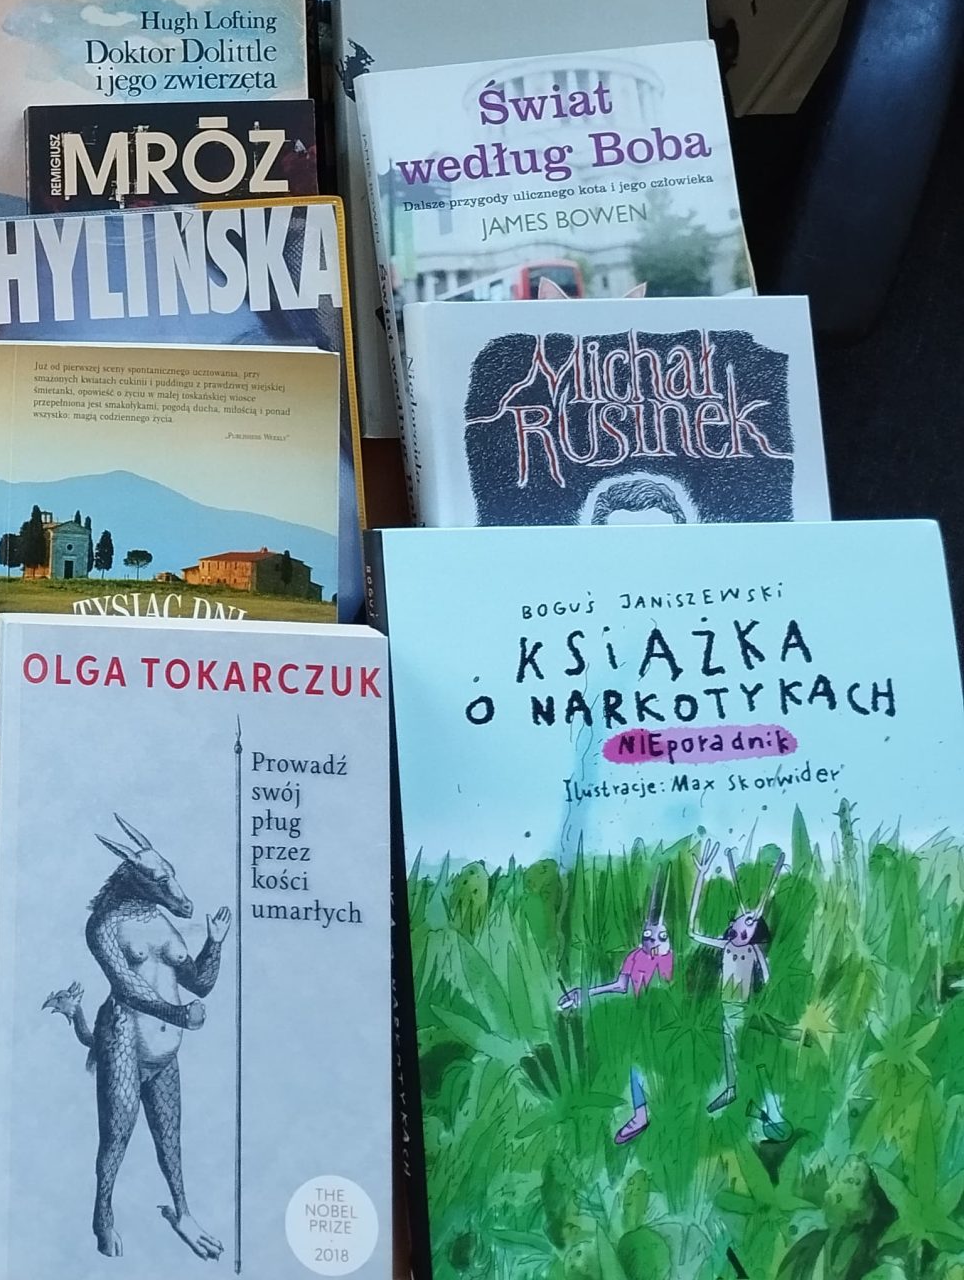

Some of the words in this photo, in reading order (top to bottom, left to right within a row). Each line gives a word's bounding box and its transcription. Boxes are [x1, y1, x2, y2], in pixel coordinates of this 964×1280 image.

[141, 11, 197, 34] Hugh
[204, 11, 277, 33] Lofting
[85, 40, 175, 64] Doktor
[181, 39, 277, 63] Dolittle
[95, 67, 102, 90] i
[105, 67, 156, 96] jego
[164, 66, 277, 93] zwierzęta
[478, 79, 613, 125] Świat
[50, 133, 61, 196] REMIGIUSZ
[396, 142, 573, 185] według
[589, 127, 712, 168] Boba
[404, 200, 445, 212] Dalsze
[449, 193, 508, 210] przygody
[513, 188, 574, 202] ulicznego
[578, 182, 607, 196] kota
[612, 182, 615, 192] i
[619, 180, 646, 193] jego
[650, 174, 713, 188] człowieka
[482, 214, 548, 241] JAMES
[556, 203, 647, 229] BOWEN
[23, 653, 126, 687] OLGA
[141, 658, 382, 698] TOKARCZUK
[466, 695, 494, 725] O
[531, 675, 896, 728] NARKOTYKACH
[251, 752, 347, 776] Prowadź
[251, 783, 301, 808] swój
[565, 777, 665, 801] Ilustracje:
[672, 776, 715, 793] Max
[729, 766, 842, 792] Skorwider
[251, 810, 302, 838] pług
[251, 844, 310, 866] przez
[251, 868, 309, 891] kości
[251, 900, 362, 928] umarłych
[316, 1188, 344, 1202] THE
[305, 1204, 358, 1218] NOBEL
[310, 1220, 351, 1234] PRIZE
[315, 1248, 349, 1262] 2018
